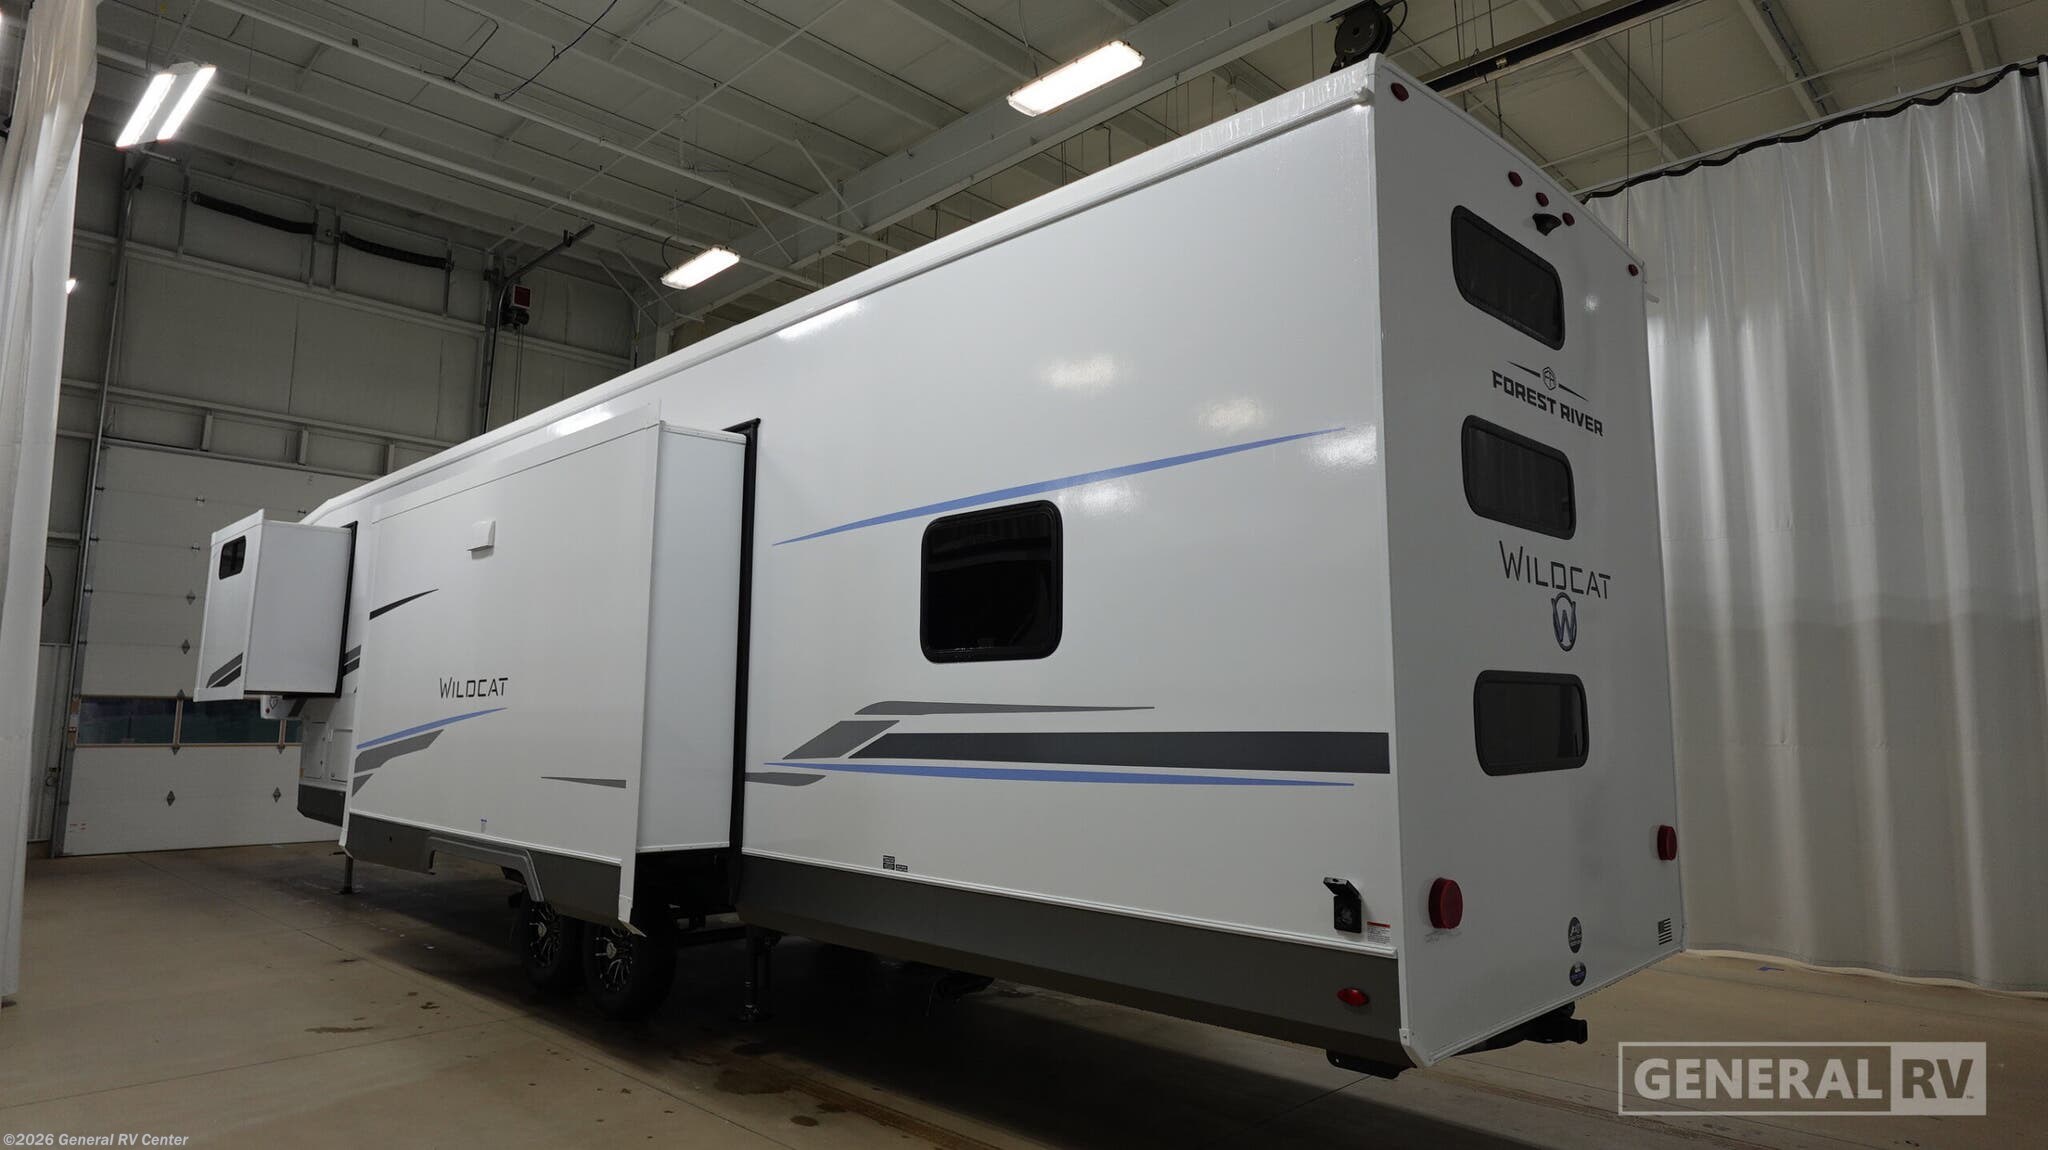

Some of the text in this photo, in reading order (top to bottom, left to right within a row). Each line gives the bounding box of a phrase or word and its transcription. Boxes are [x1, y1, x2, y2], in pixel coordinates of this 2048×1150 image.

[1491, 369, 1604, 437] FOREST RIVER
[1499, 540, 1611, 599] WILDCAT
[439, 677, 509, 699] WILDCAT
